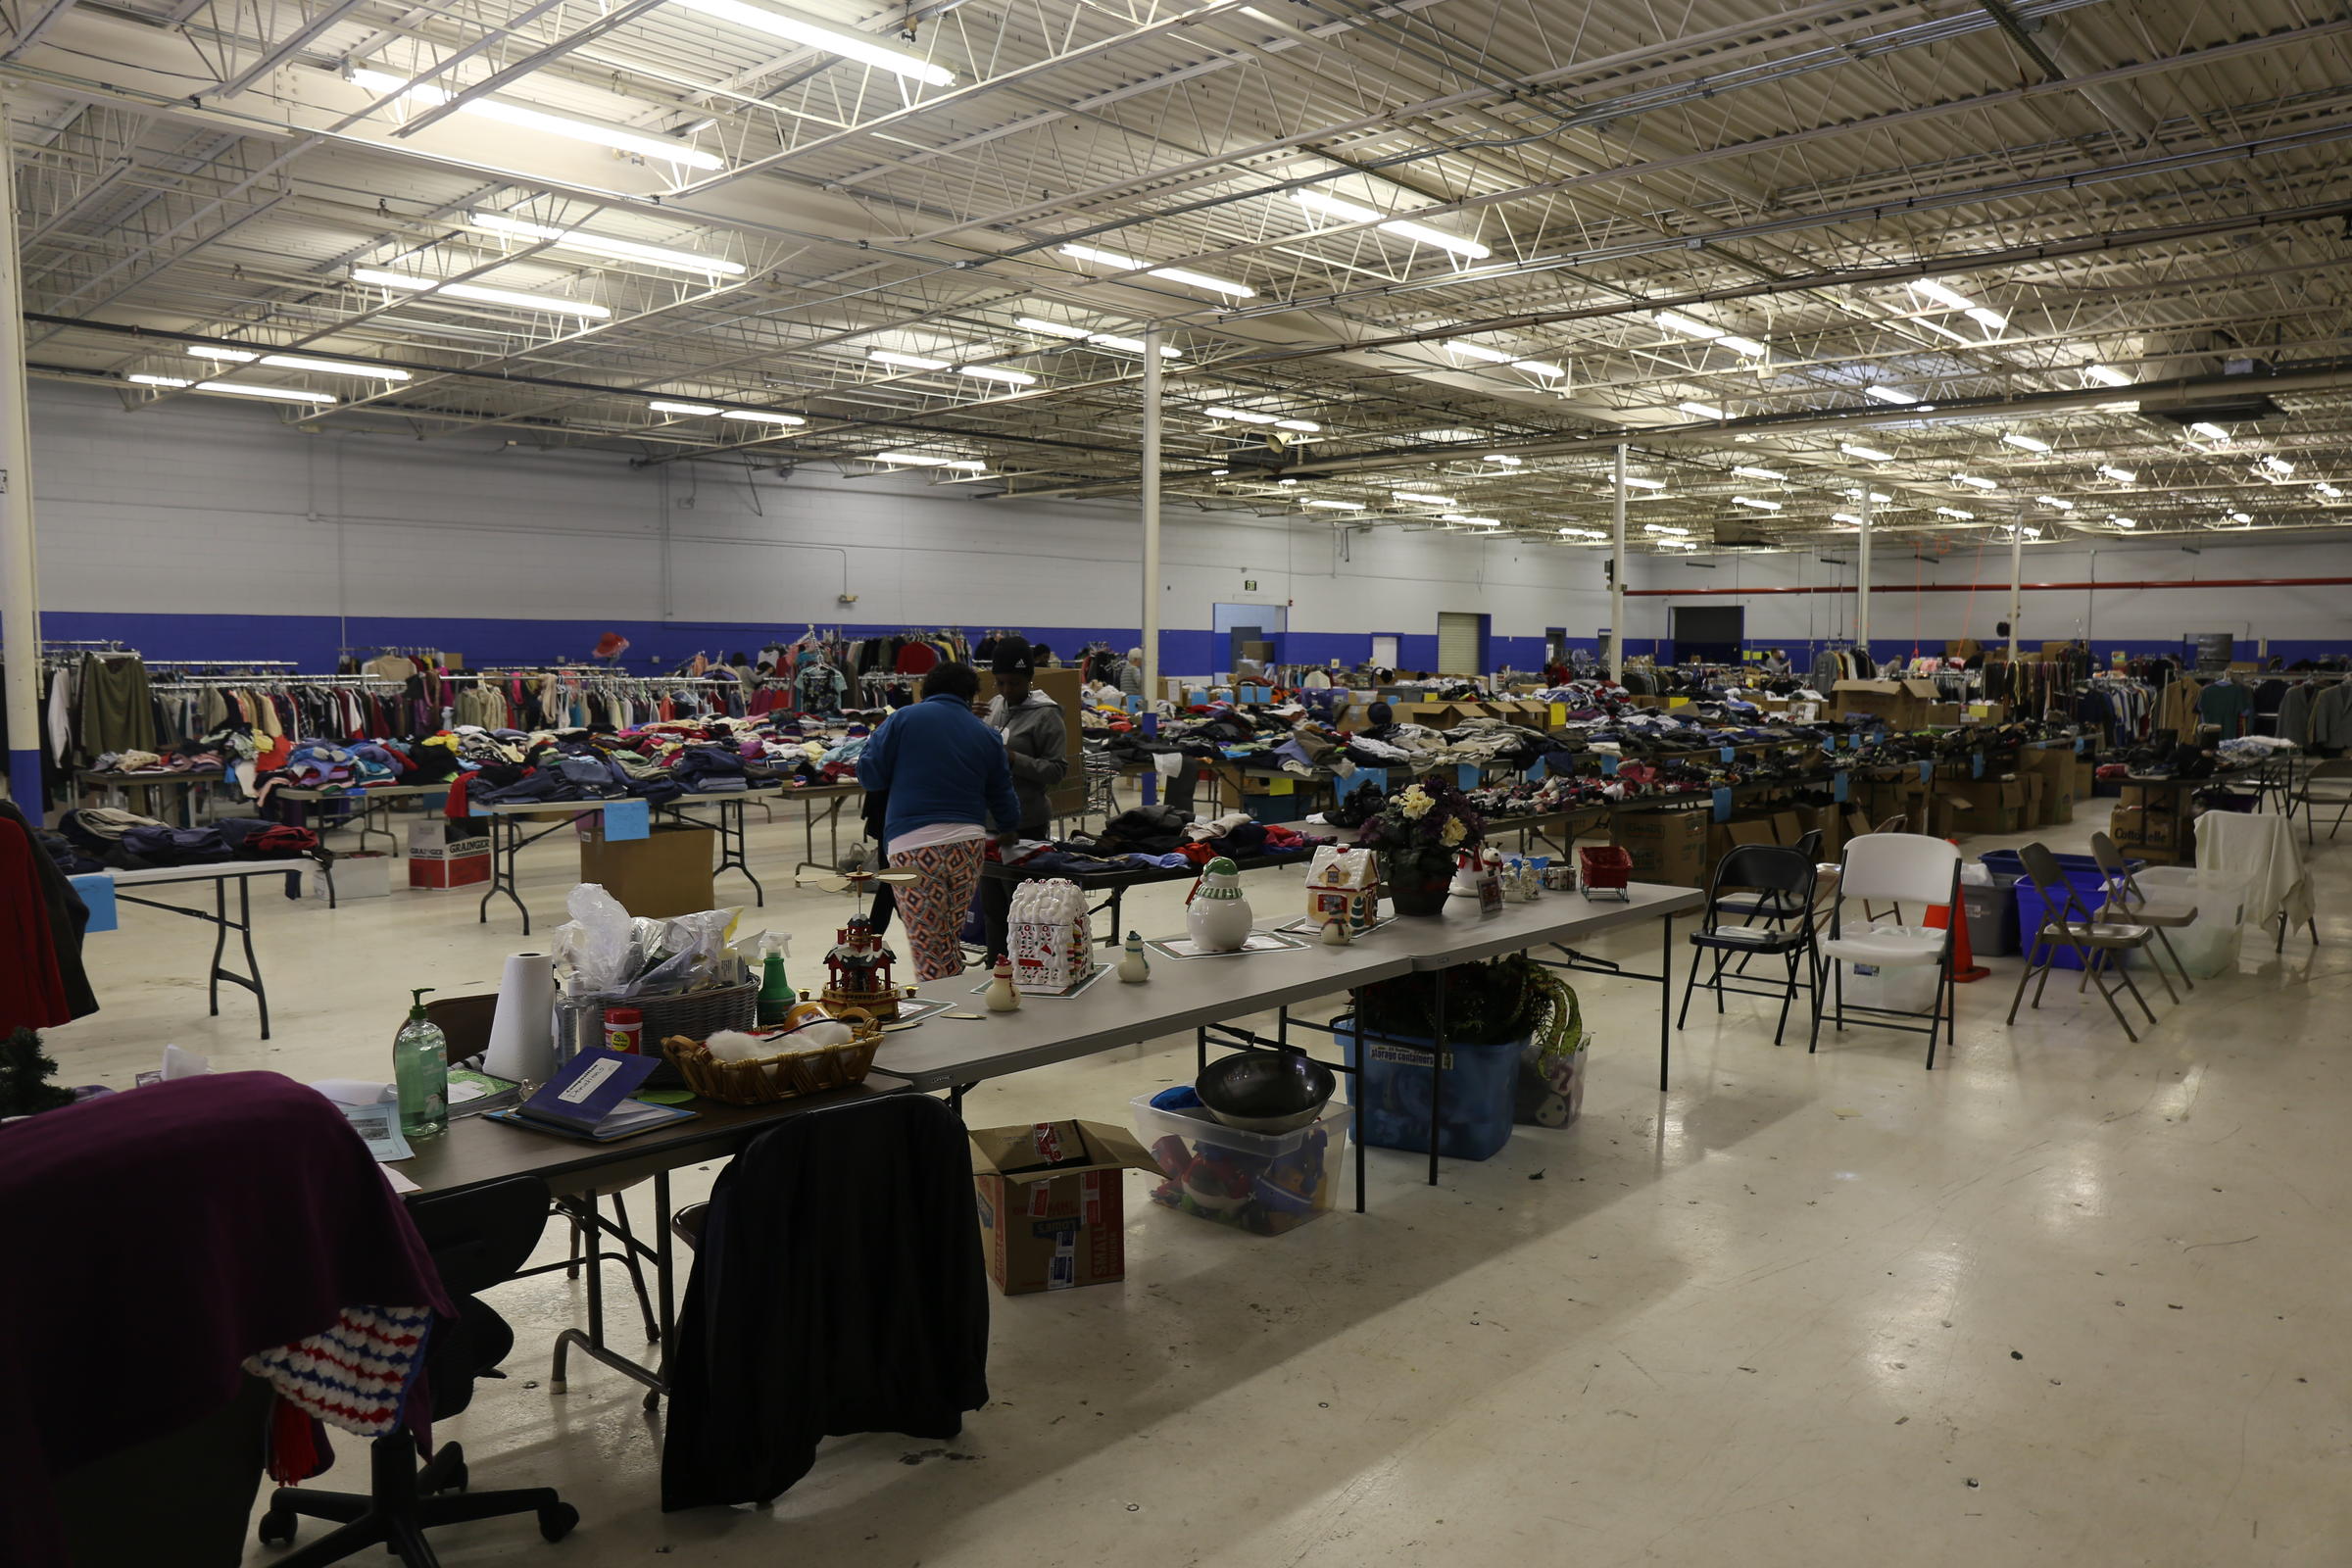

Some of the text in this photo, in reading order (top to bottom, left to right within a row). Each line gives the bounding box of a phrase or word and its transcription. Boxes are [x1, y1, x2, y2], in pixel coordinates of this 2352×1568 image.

[2115, 827, 2167, 842] Cottoelle
[410, 847, 443, 856] GRAIGER
[449, 839, 490, 854] GRAINGER
[1371, 1048, 1396, 1060] storage
[1094, 1224, 1106, 1275] SMALL
